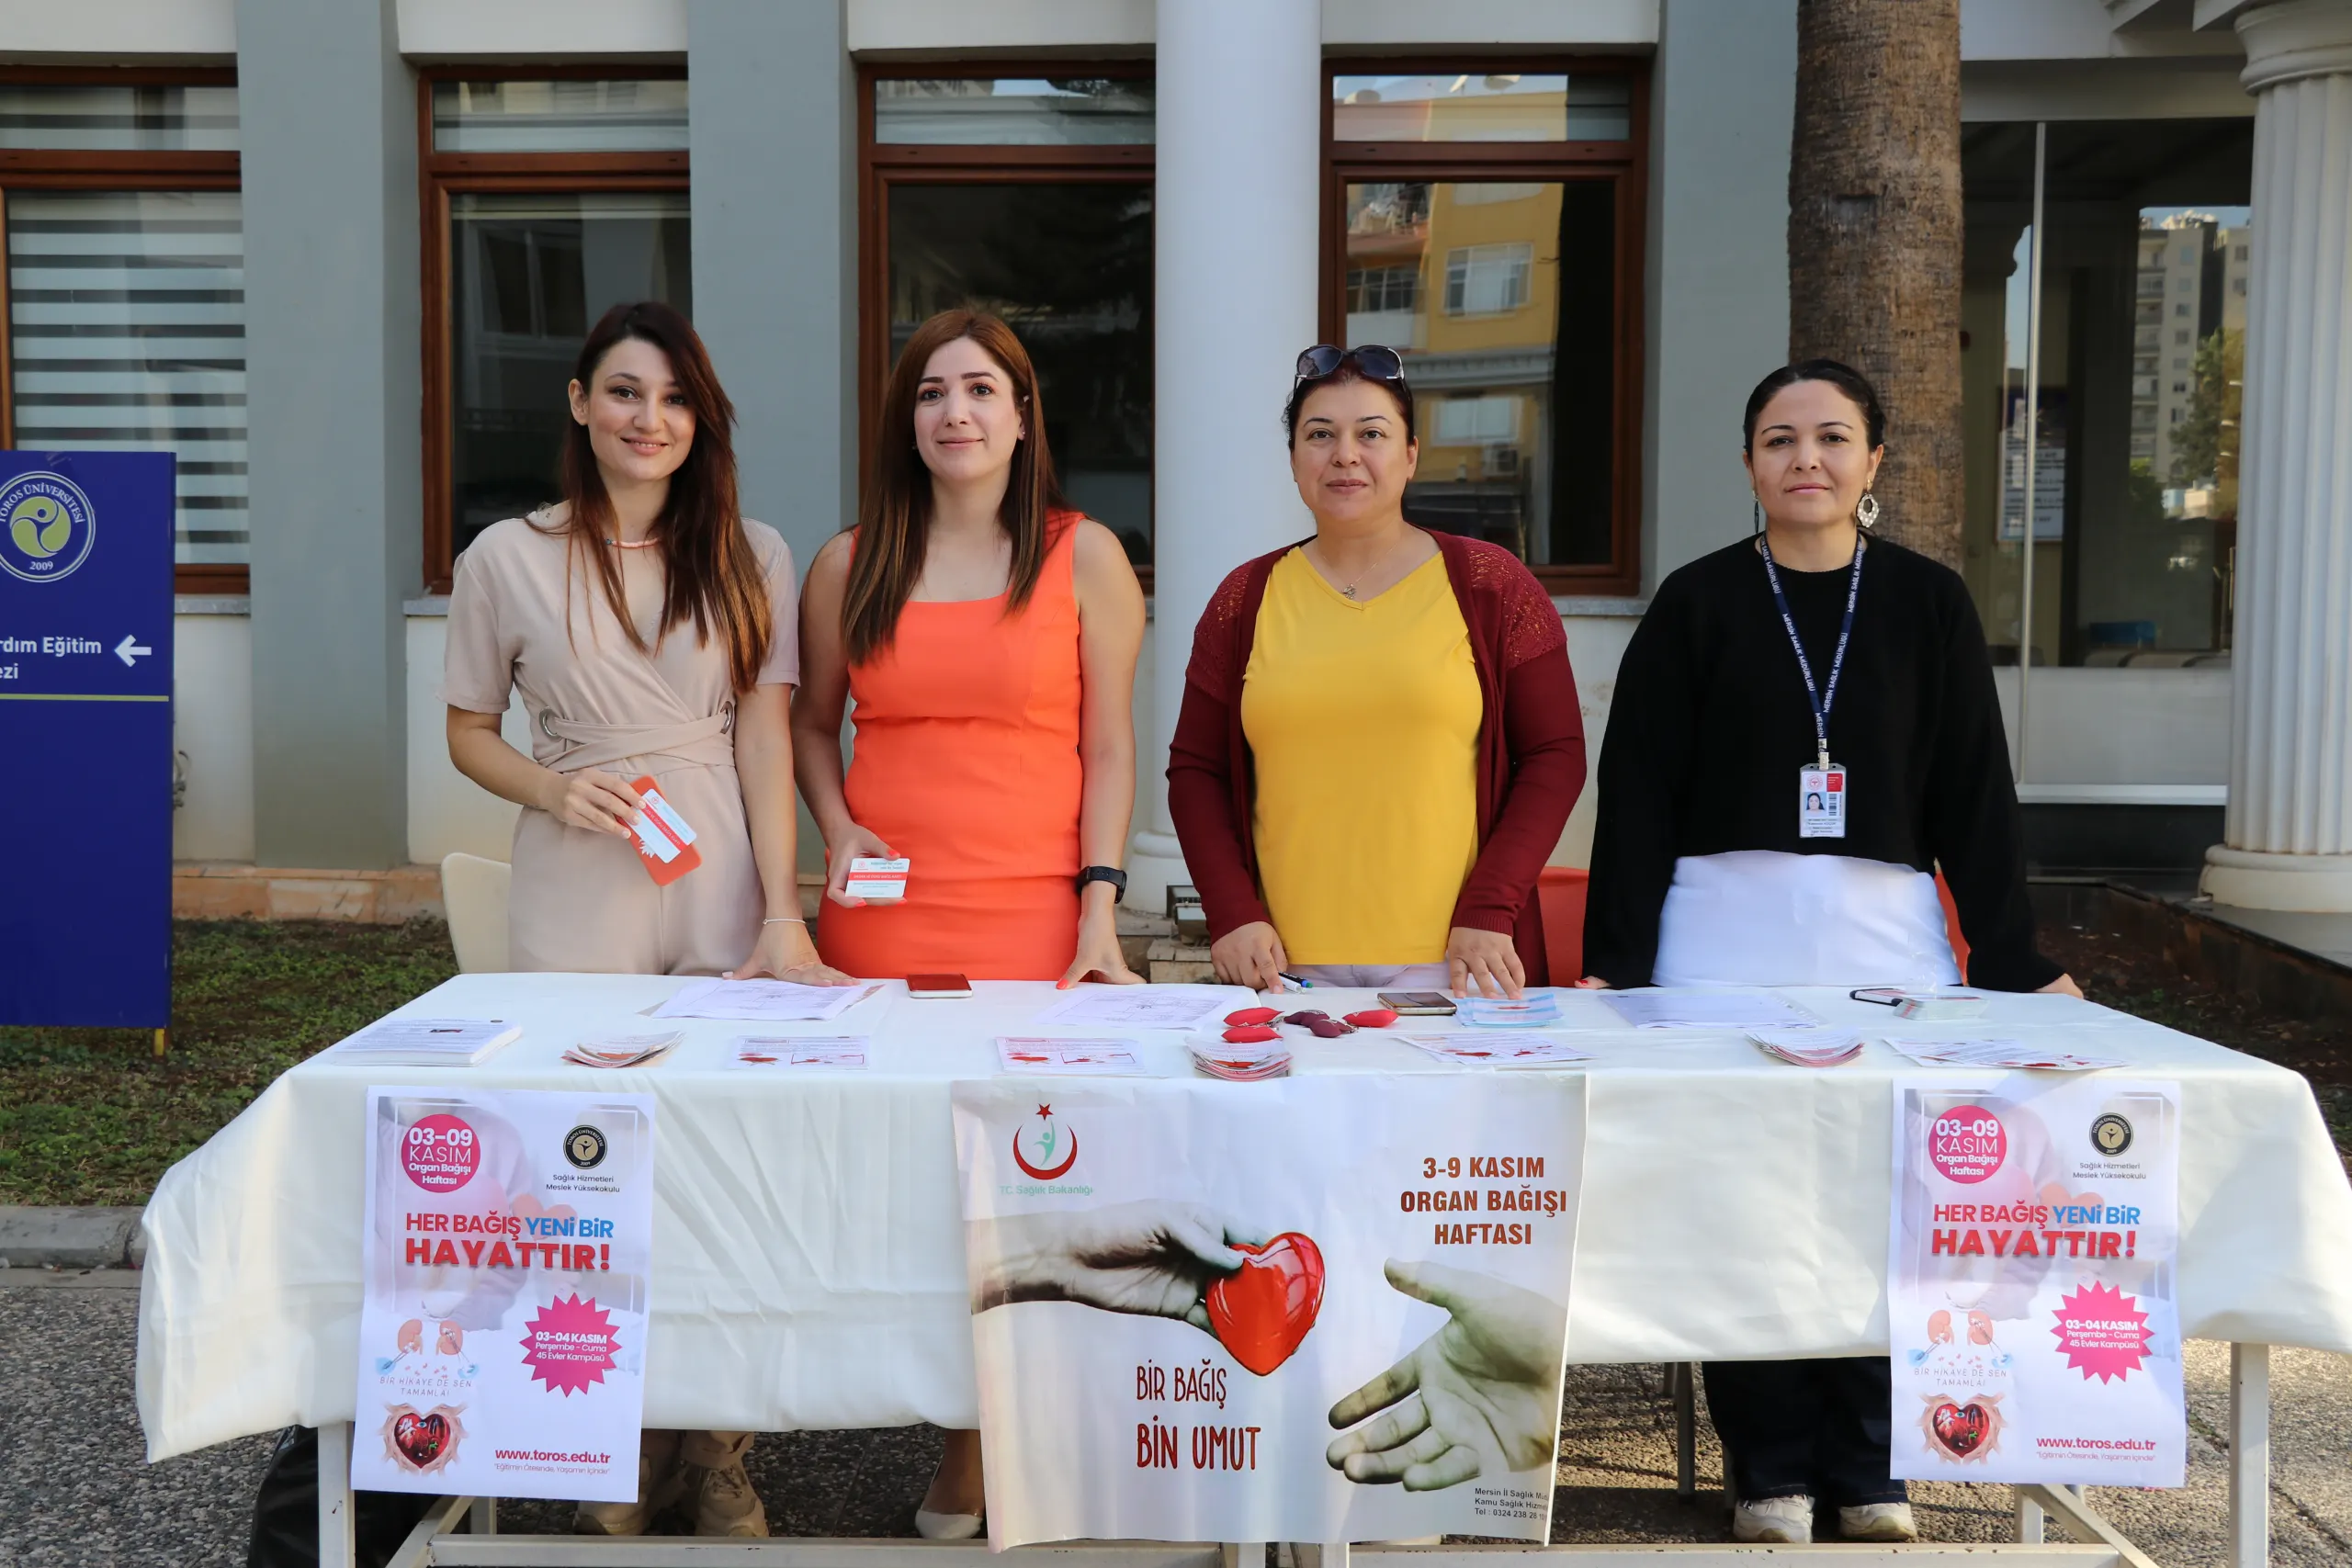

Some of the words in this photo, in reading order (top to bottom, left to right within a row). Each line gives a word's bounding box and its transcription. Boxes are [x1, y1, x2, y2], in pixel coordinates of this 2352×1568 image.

[23, 482, 85, 524] ÜNİVERSİTESİ
[29, 561, 54, 570] 2009
[43, 636, 102, 657] Eğitim
[1936, 1119, 1998, 1137] 03-09
[409, 1127, 472, 1146] 03-09
[1937, 1137, 1997, 1154] KASIM
[410, 1145, 471, 1163] KASIM
[1936, 1154, 1967, 1165] Organ
[1968, 1154, 1998, 1166] Bağışı
[409, 1162, 440, 1174] Organ
[441, 1163, 471, 1176] Bağışı
[1423, 1156, 1461, 1179] 3-9
[1469, 1156, 1544, 1178] KASIM
[1950, 1166, 1984, 1176] Haftası
[2079, 1162, 2102, 1170] Sağlık
[423, 1175, 458, 1185] Haftası
[546, 1183, 572, 1191] Meslek
[573, 1184, 620, 1192] Yüksekokulu
[1016, 1185, 1046, 1196] Sağlık
[1048, 1185, 1093, 1196] Bakanlığı
[1400, 1190, 1477, 1213] ORGAN
[1487, 1184, 1566, 1217] BAĞIŞI
[1933, 1204, 1976, 1223] HER
[1980, 1200, 2048, 1229] BAĞIŞ
[406, 1213, 449, 1232] HER
[453, 1210, 521, 1240] BAĞIŞ
[1434, 1224, 1532, 1245] HAFTASI
[1931, 1229, 2136, 1258] HAYATTIR!
[406, 1237, 610, 1270] HAYATTIR!
[2065, 1319, 2101, 1330] 03-04
[2101, 1320, 2139, 1331] KASIM
[536, 1331, 570, 1342] 03-04
[571, 1333, 607, 1344] KASIM
[2066, 1330, 2107, 1339] Perşembe
[535, 1342, 574, 1351] Perşembe
[582, 1344, 606, 1352] Cuma
[2081, 1339, 2099, 1348] Evler
[2100, 1341, 2139, 1350] Kampüsü
[567, 1353, 605, 1363] Kampüsü
[1972, 1369, 1984, 1377] DE
[1988, 1369, 2007, 1377] SEN
[1136, 1359, 1165, 1401] BİR
[1174, 1359, 1227, 1409] BAĞIŞ
[1136, 1415, 1178, 1470] BİN
[1193, 1426, 1261, 1471] UMUT
[2036, 1437, 2156, 1450] www.toros.edu.tr
[495, 1450, 611, 1463] www.toros.edu.tr
[1475, 1488, 1501, 1496] Mersin
[1503, 1488, 1508, 1496] İl
[1510, 1490, 1533, 1499] Sağlık
[1475, 1497, 1498, 1506] Kamu
[1499, 1499, 1523, 1509] Sağlık
[1493, 1508, 1511, 1517] 0324
[1513, 1510, 1527, 1518] 238
